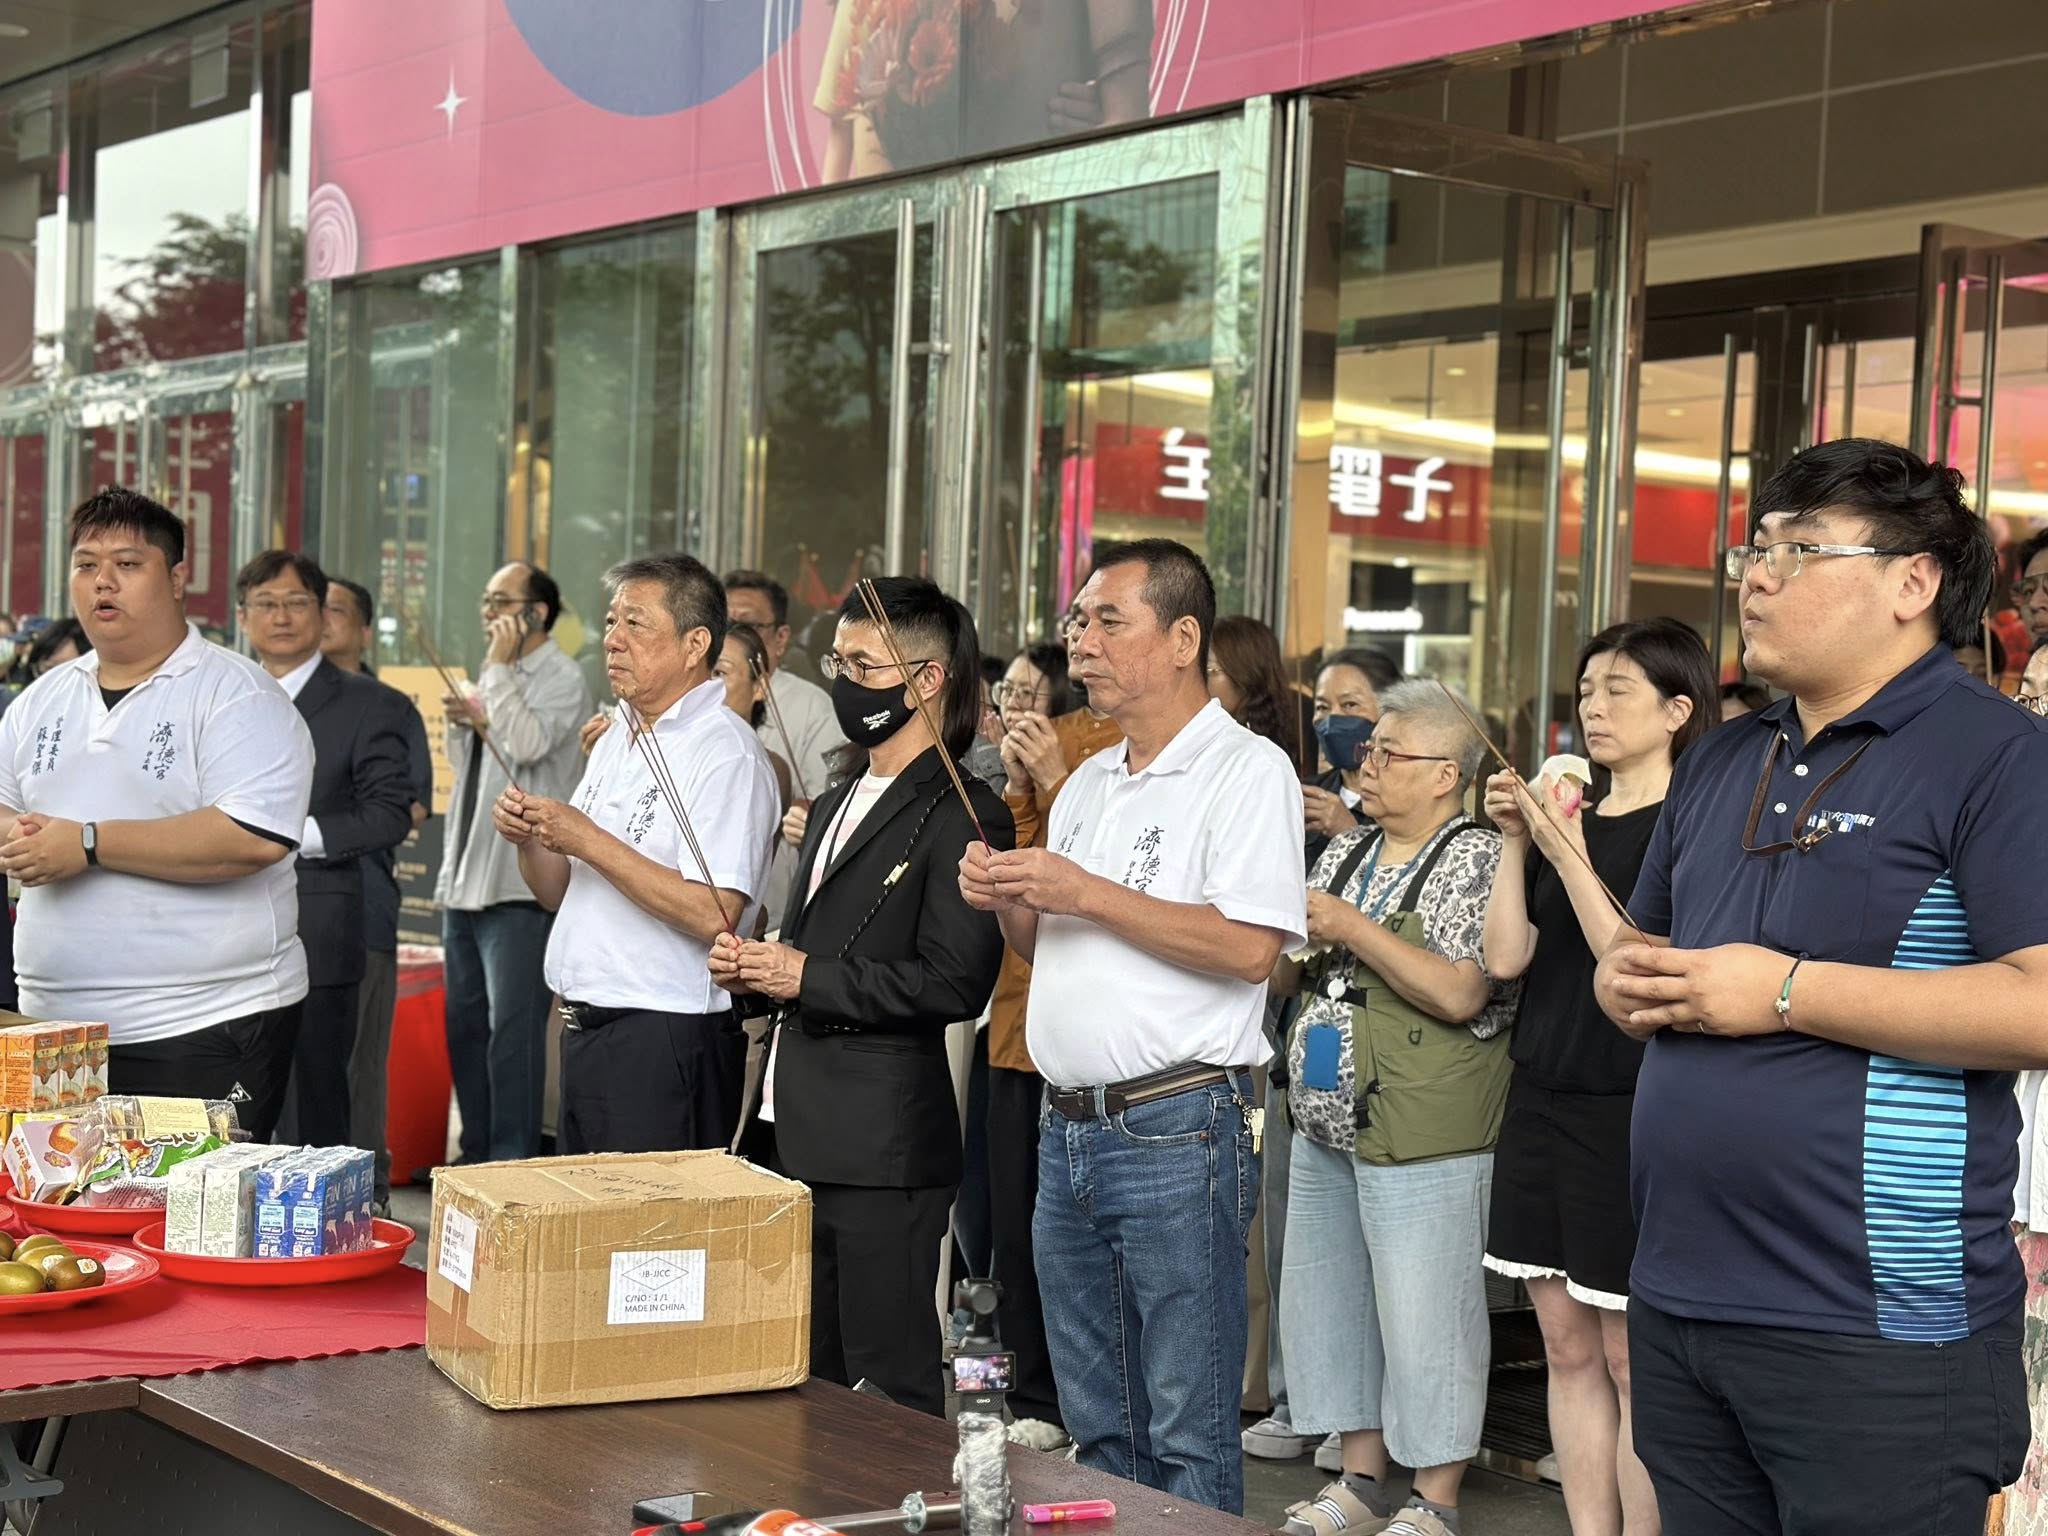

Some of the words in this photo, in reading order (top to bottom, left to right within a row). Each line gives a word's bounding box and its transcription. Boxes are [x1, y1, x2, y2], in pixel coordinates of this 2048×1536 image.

[863, 709, 891, 723] Reebok
[150, 721, 175, 780] 濟德宮
[634, 785, 661, 844] 濟德宮
[660, 1303, 685, 1311] CHINA
